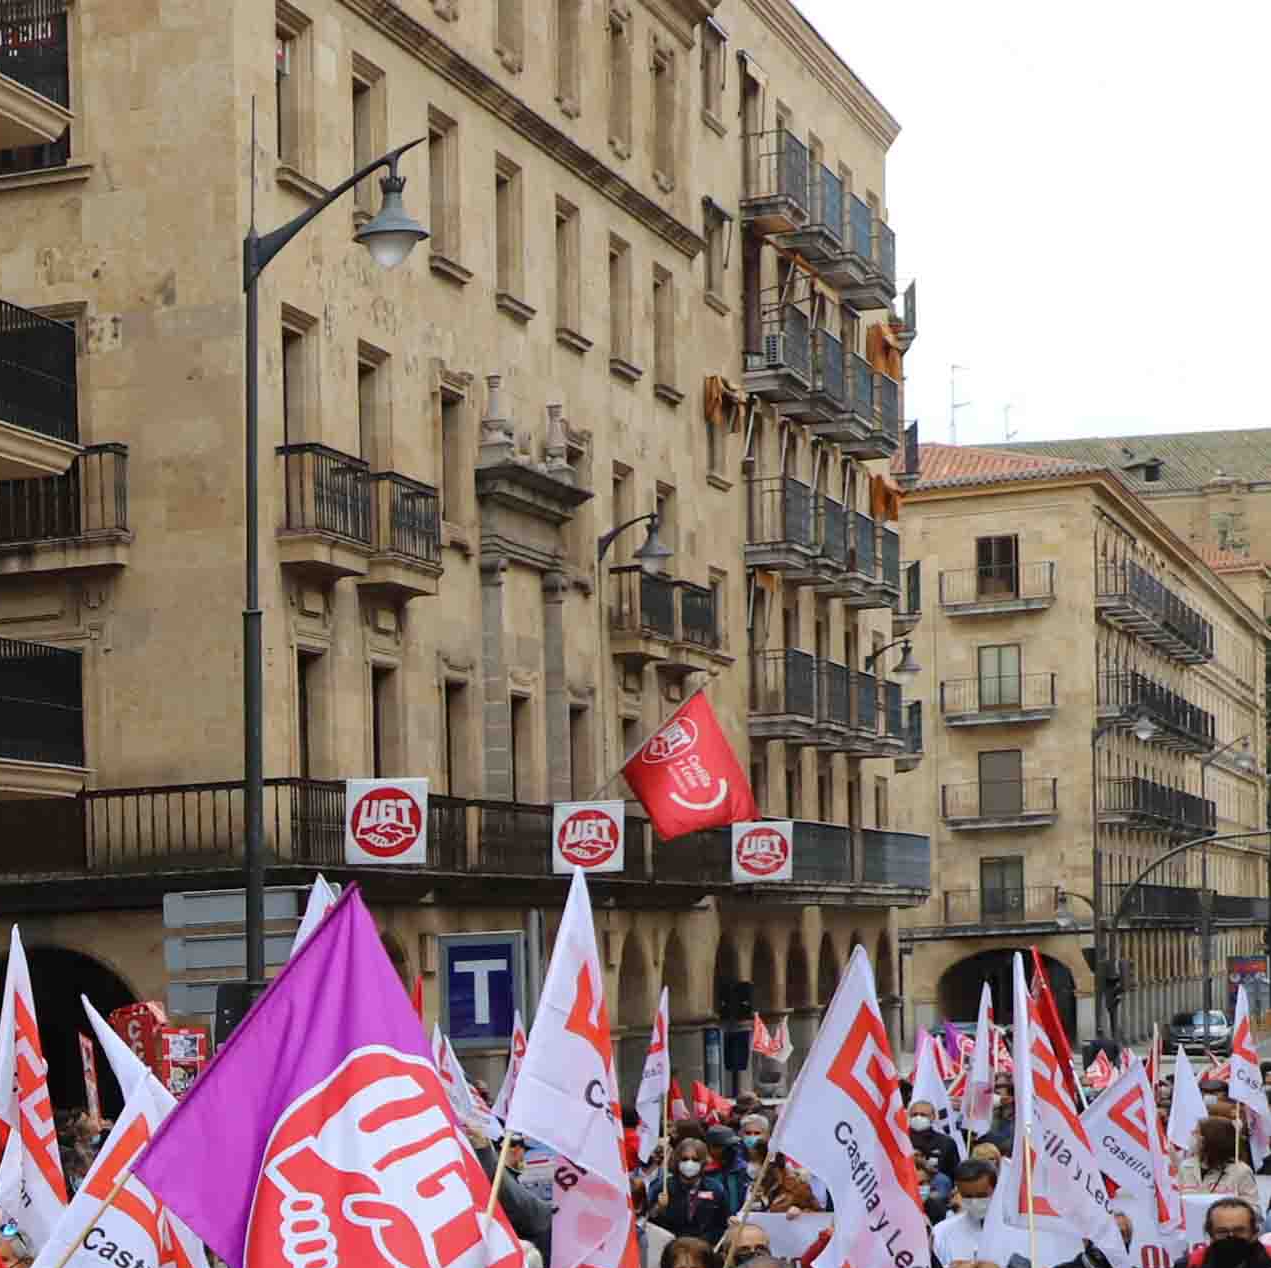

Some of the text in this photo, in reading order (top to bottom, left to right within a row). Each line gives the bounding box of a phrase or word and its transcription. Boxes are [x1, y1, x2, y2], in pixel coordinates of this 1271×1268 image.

[360, 799, 412, 827] UGT
[566, 819, 610, 843] UGT
[744, 836, 781, 856] UGT
[835, 1121, 881, 1212] Castilla
[869, 1211, 889, 1232] y
